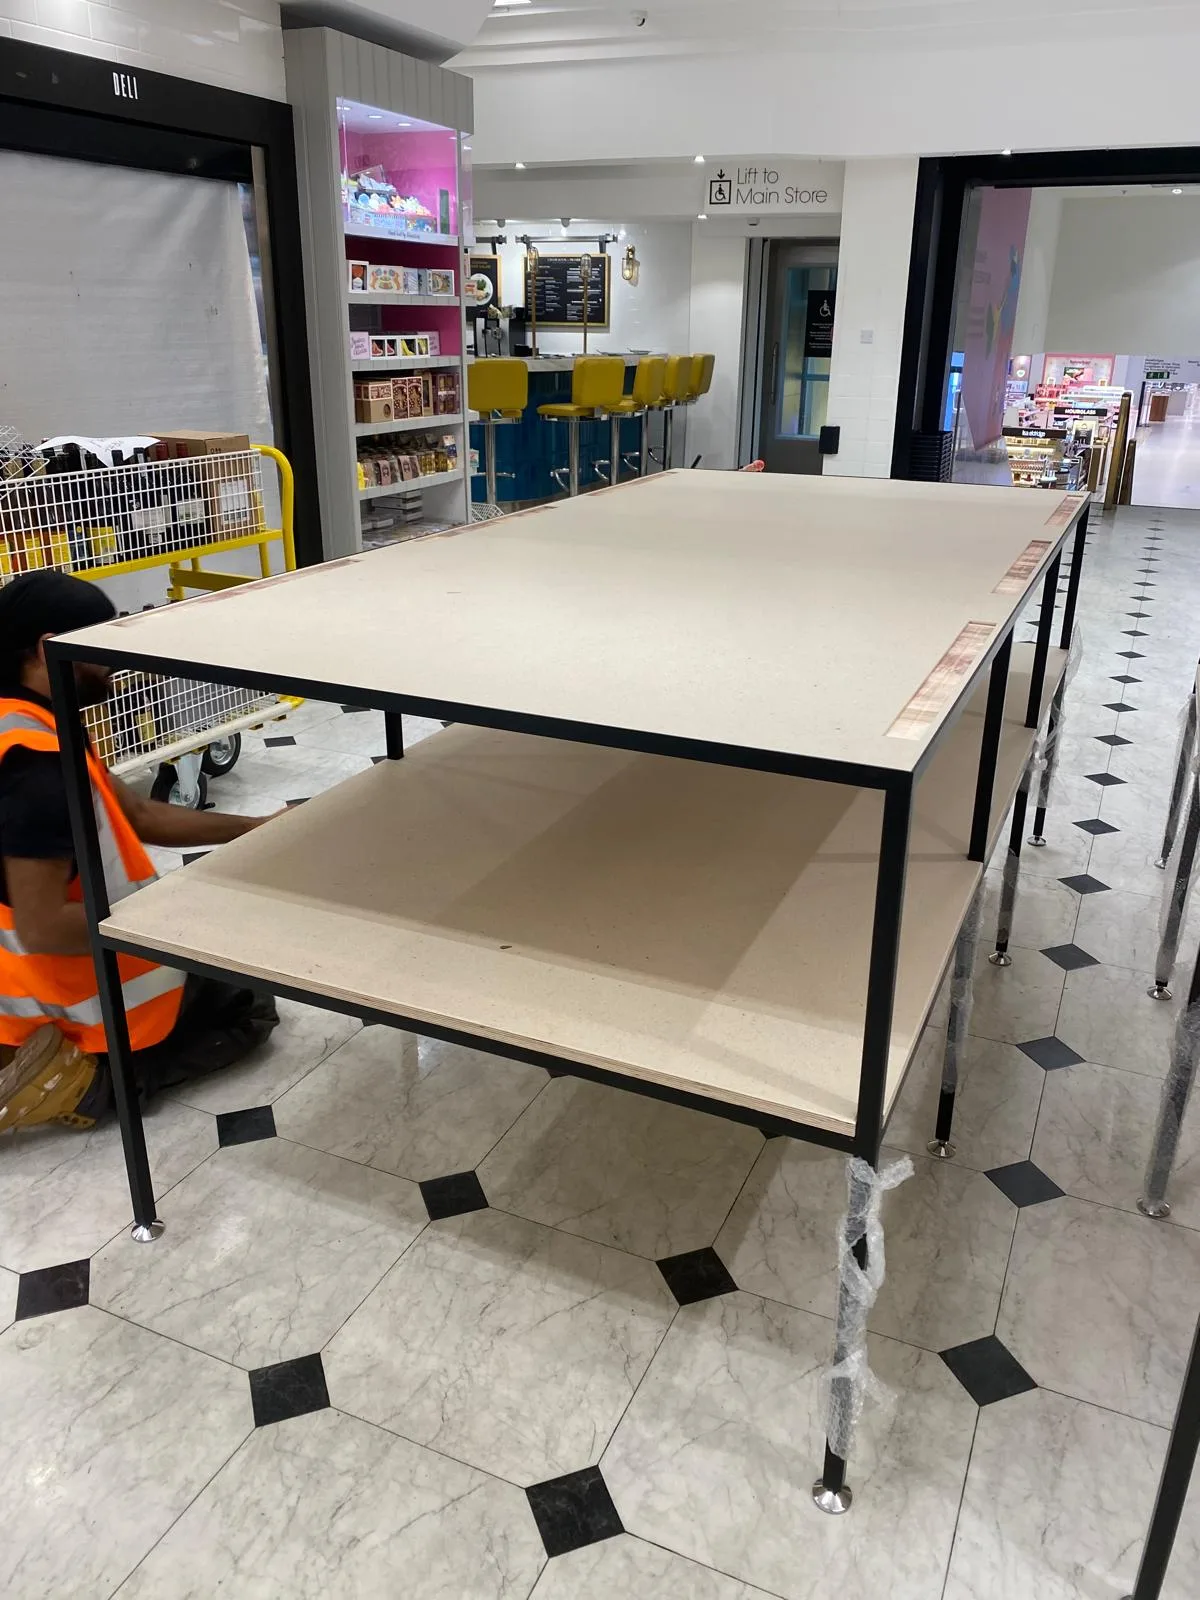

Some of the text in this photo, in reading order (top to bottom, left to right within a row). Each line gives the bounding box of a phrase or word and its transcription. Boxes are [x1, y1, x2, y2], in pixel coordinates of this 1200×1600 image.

[112, 71, 138, 100] DELI
[737, 167, 779, 185] Lift to
[736, 186, 828, 205] Main Store
[1064, 408, 1097, 416] HOURGLASS
